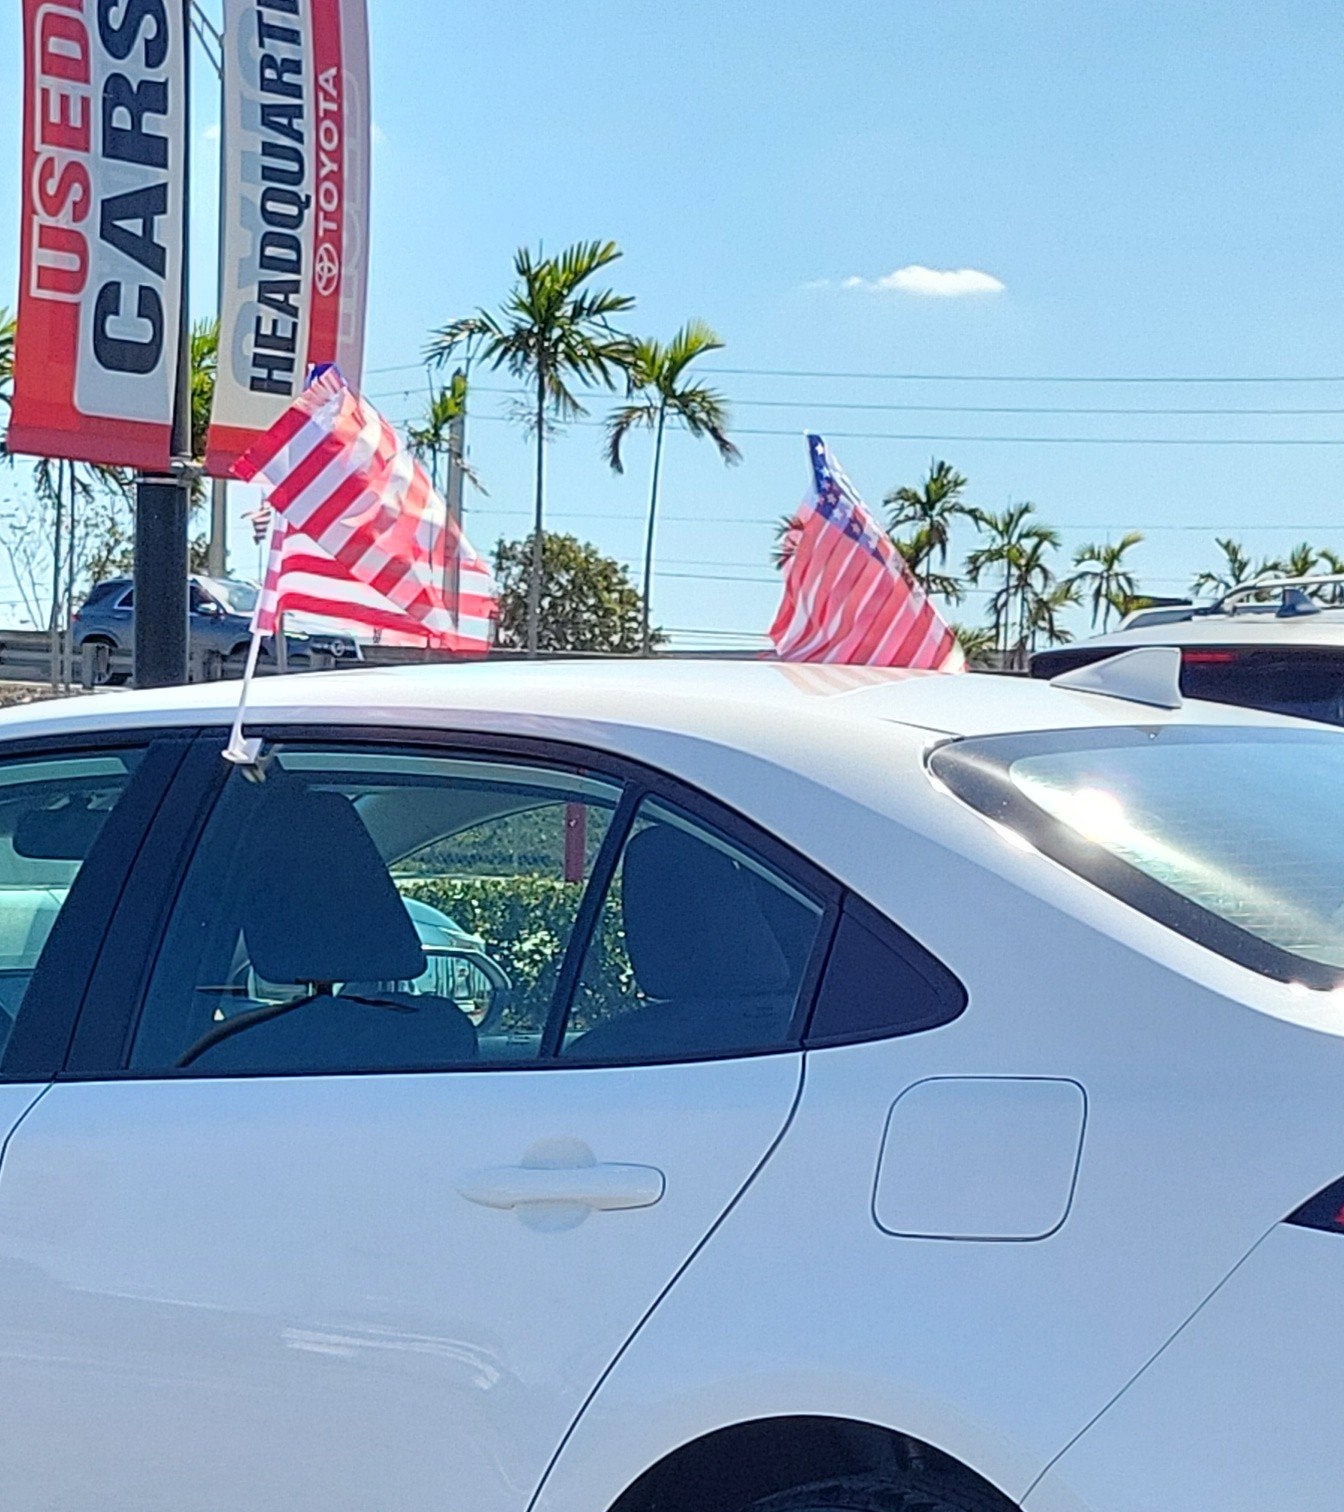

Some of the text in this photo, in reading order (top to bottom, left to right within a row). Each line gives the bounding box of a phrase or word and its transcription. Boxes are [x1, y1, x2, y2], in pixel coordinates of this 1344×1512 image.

[31, 4, 92, 302] USED
[93, 0, 170, 375] CARS
[317, 66, 339, 238] TOYOTA
